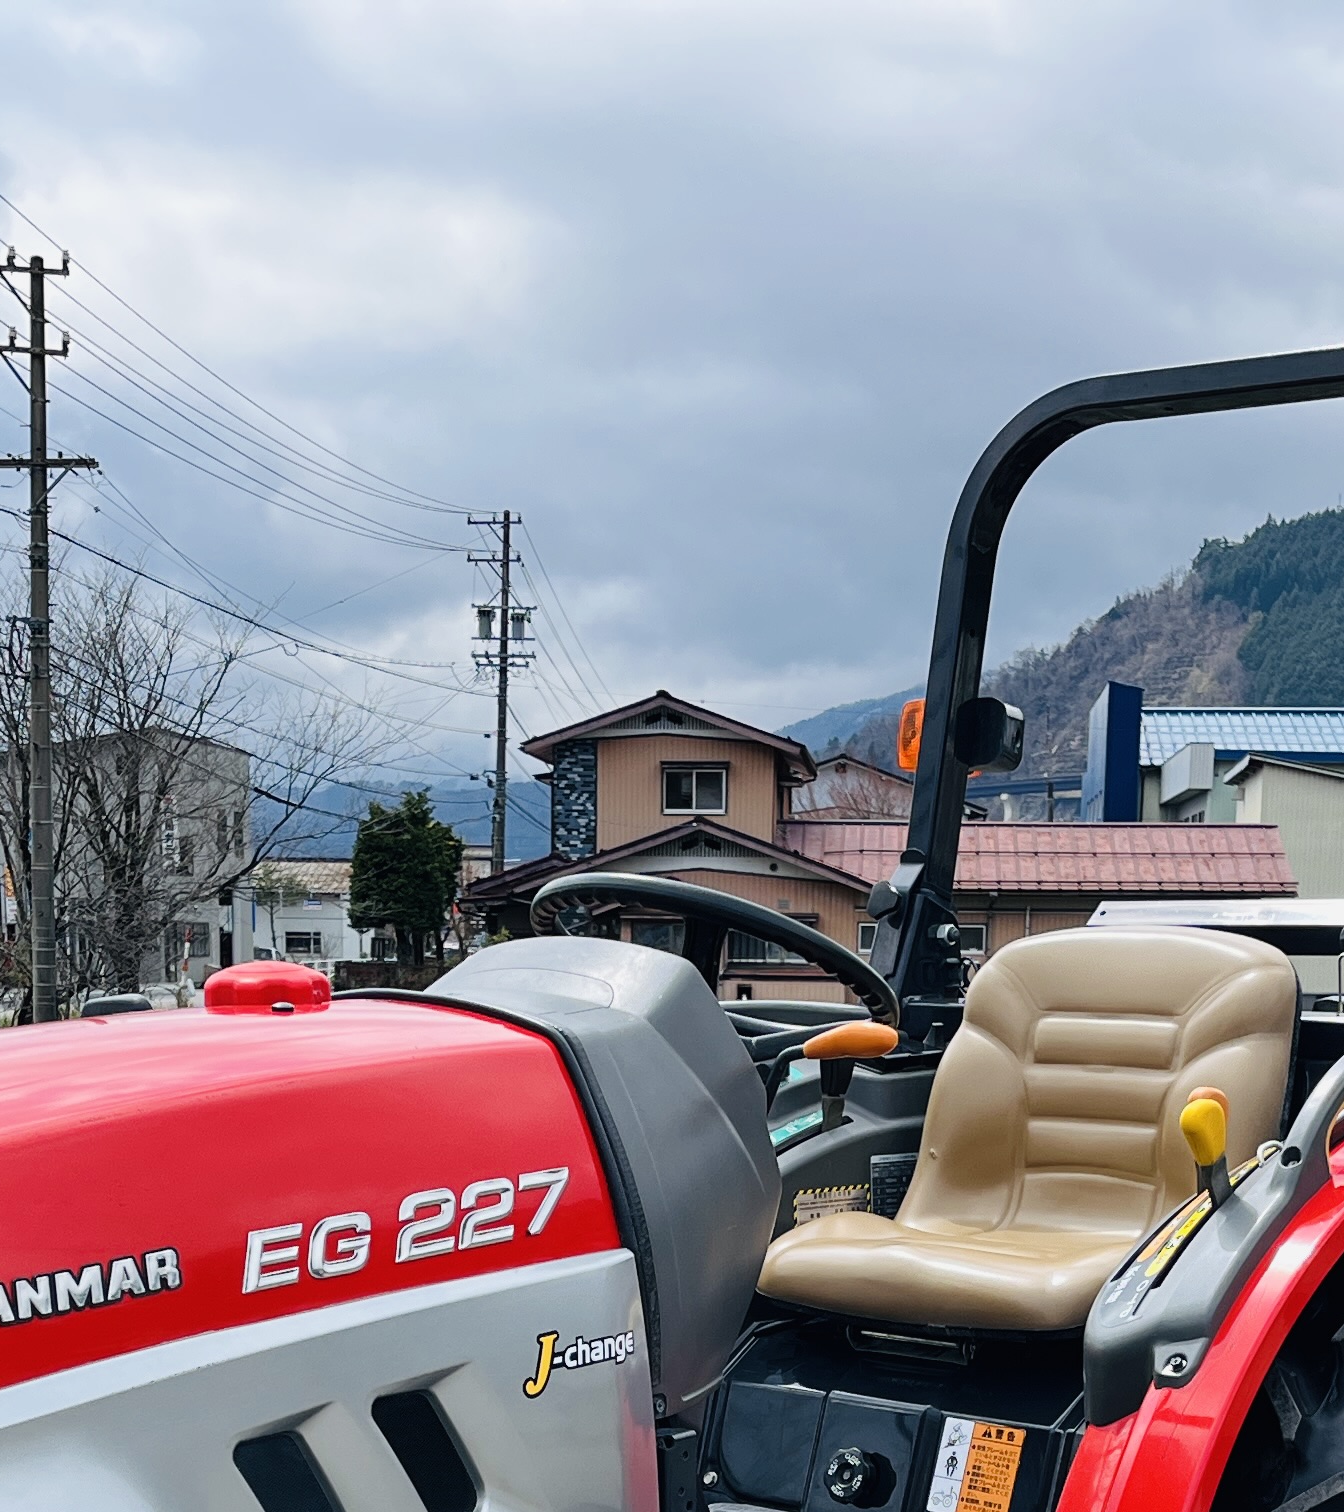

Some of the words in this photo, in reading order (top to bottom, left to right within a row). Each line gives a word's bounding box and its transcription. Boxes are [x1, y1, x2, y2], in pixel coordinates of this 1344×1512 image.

[242, 1211, 371, 1294] EG
[395, 1166, 569, 1263] 227
[523, 1330, 634, 1399] J-change
